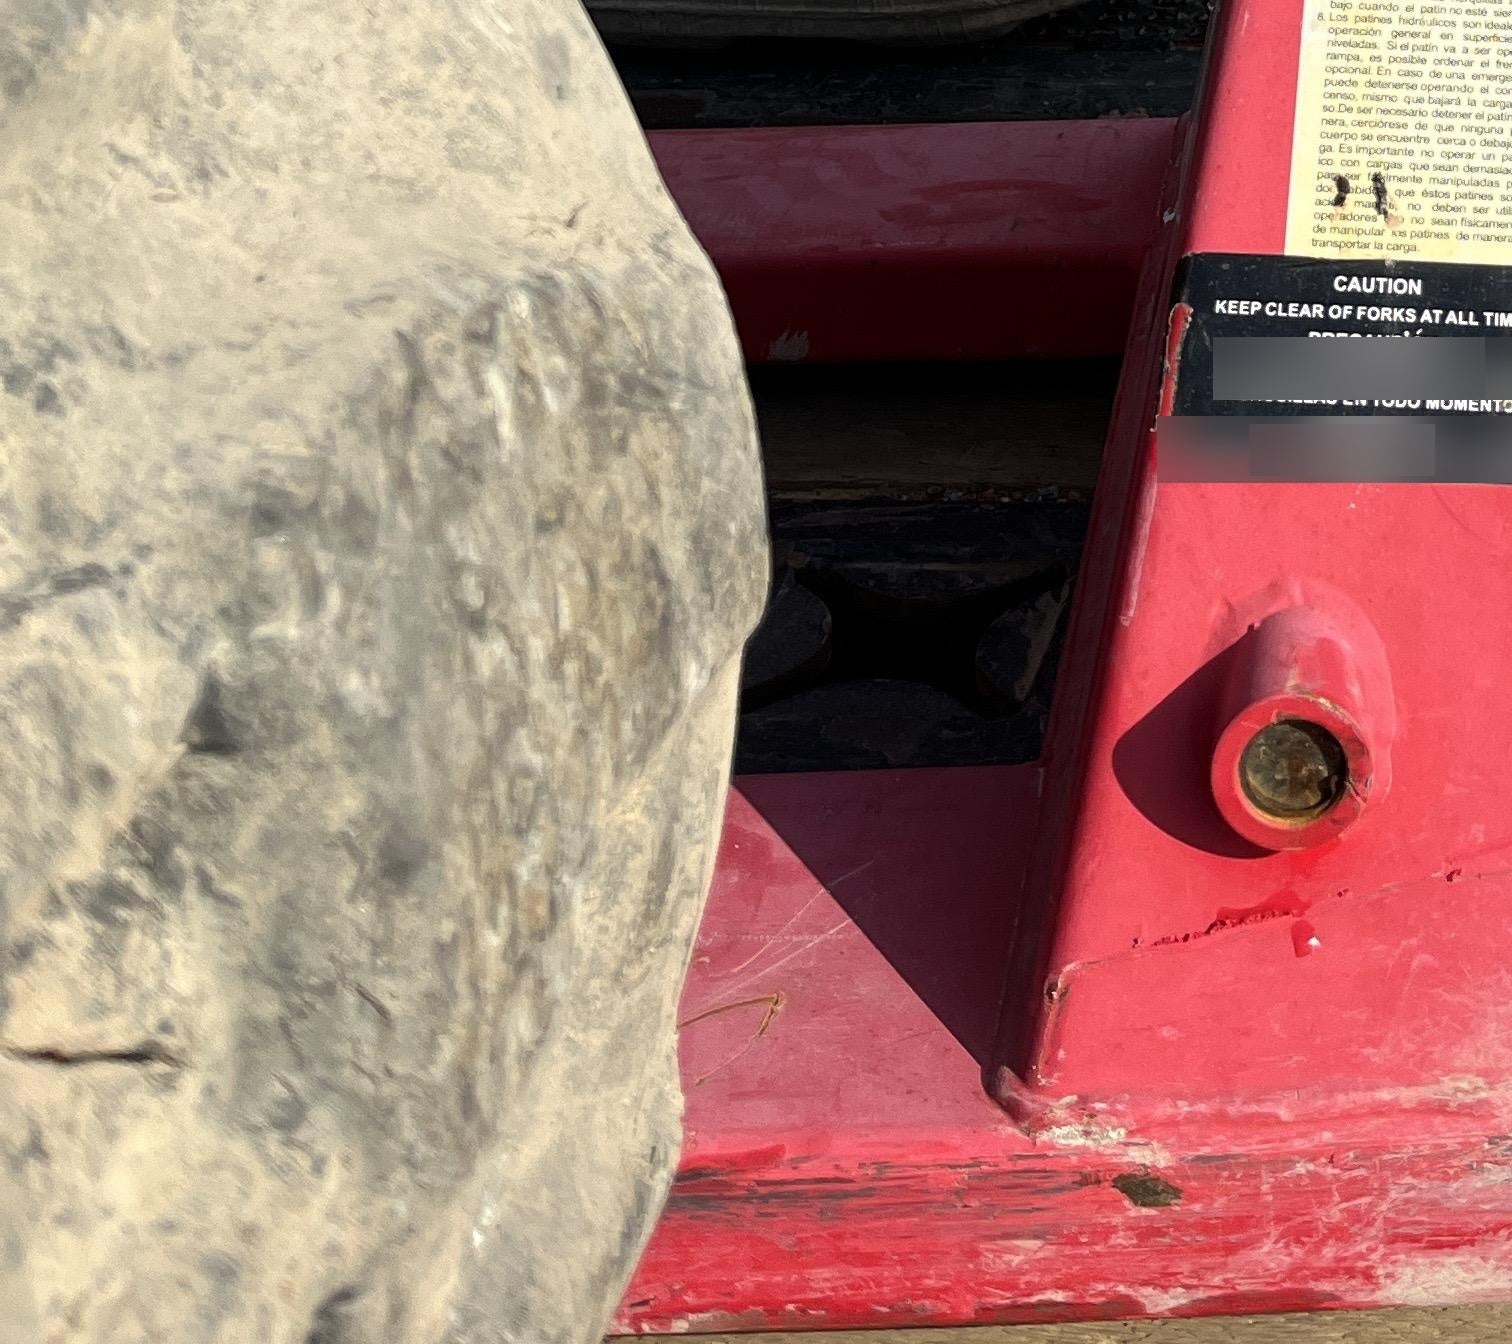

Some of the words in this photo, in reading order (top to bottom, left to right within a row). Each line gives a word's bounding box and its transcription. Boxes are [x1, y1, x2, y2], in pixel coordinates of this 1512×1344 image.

[1329, 0, 1353, 11] bajo
[1357, 0, 1400, 11] cuando
[1404, 3, 1415, 12] el
[1464, 6, 1488, 16] esté
[1387, 53, 1427, 66] posible
[1432, 56, 1473, 66] ordenar
[1480, 58, 1490, 67] el
[1375, 66, 1392, 76] En
[1396, 69, 1423, 77] caso
[1428, 68, 1443, 78] de
[1414, 120, 1428, 130] de
[1433, 124, 1455, 134] que
[1460, 122, 1504, 136] ninguna
[1337, 143, 1353, 153] Es
[1354, 144, 1415, 158] importante
[1420, 149, 1435, 157] no
[1439, 150, 1476, 162] operar
[1317, 155, 1335, 165] ico
[1339, 159, 1360, 167] con
[1365, 160, 1403, 171] cargas
[1408, 162, 1430, 173] que
[1431, 164, 1459, 172] sean
[1333, 275, 1423, 296] CAUTION
[1214, 299, 1263, 315] KEEP
[1265, 301, 1325, 319] CLEAR
[1328, 304, 1354, 320] OF
[1356, 306, 1417, 323] FORKS
[1419, 308, 1444, 324] AT
[1444, 310, 1479, 326] ALL
